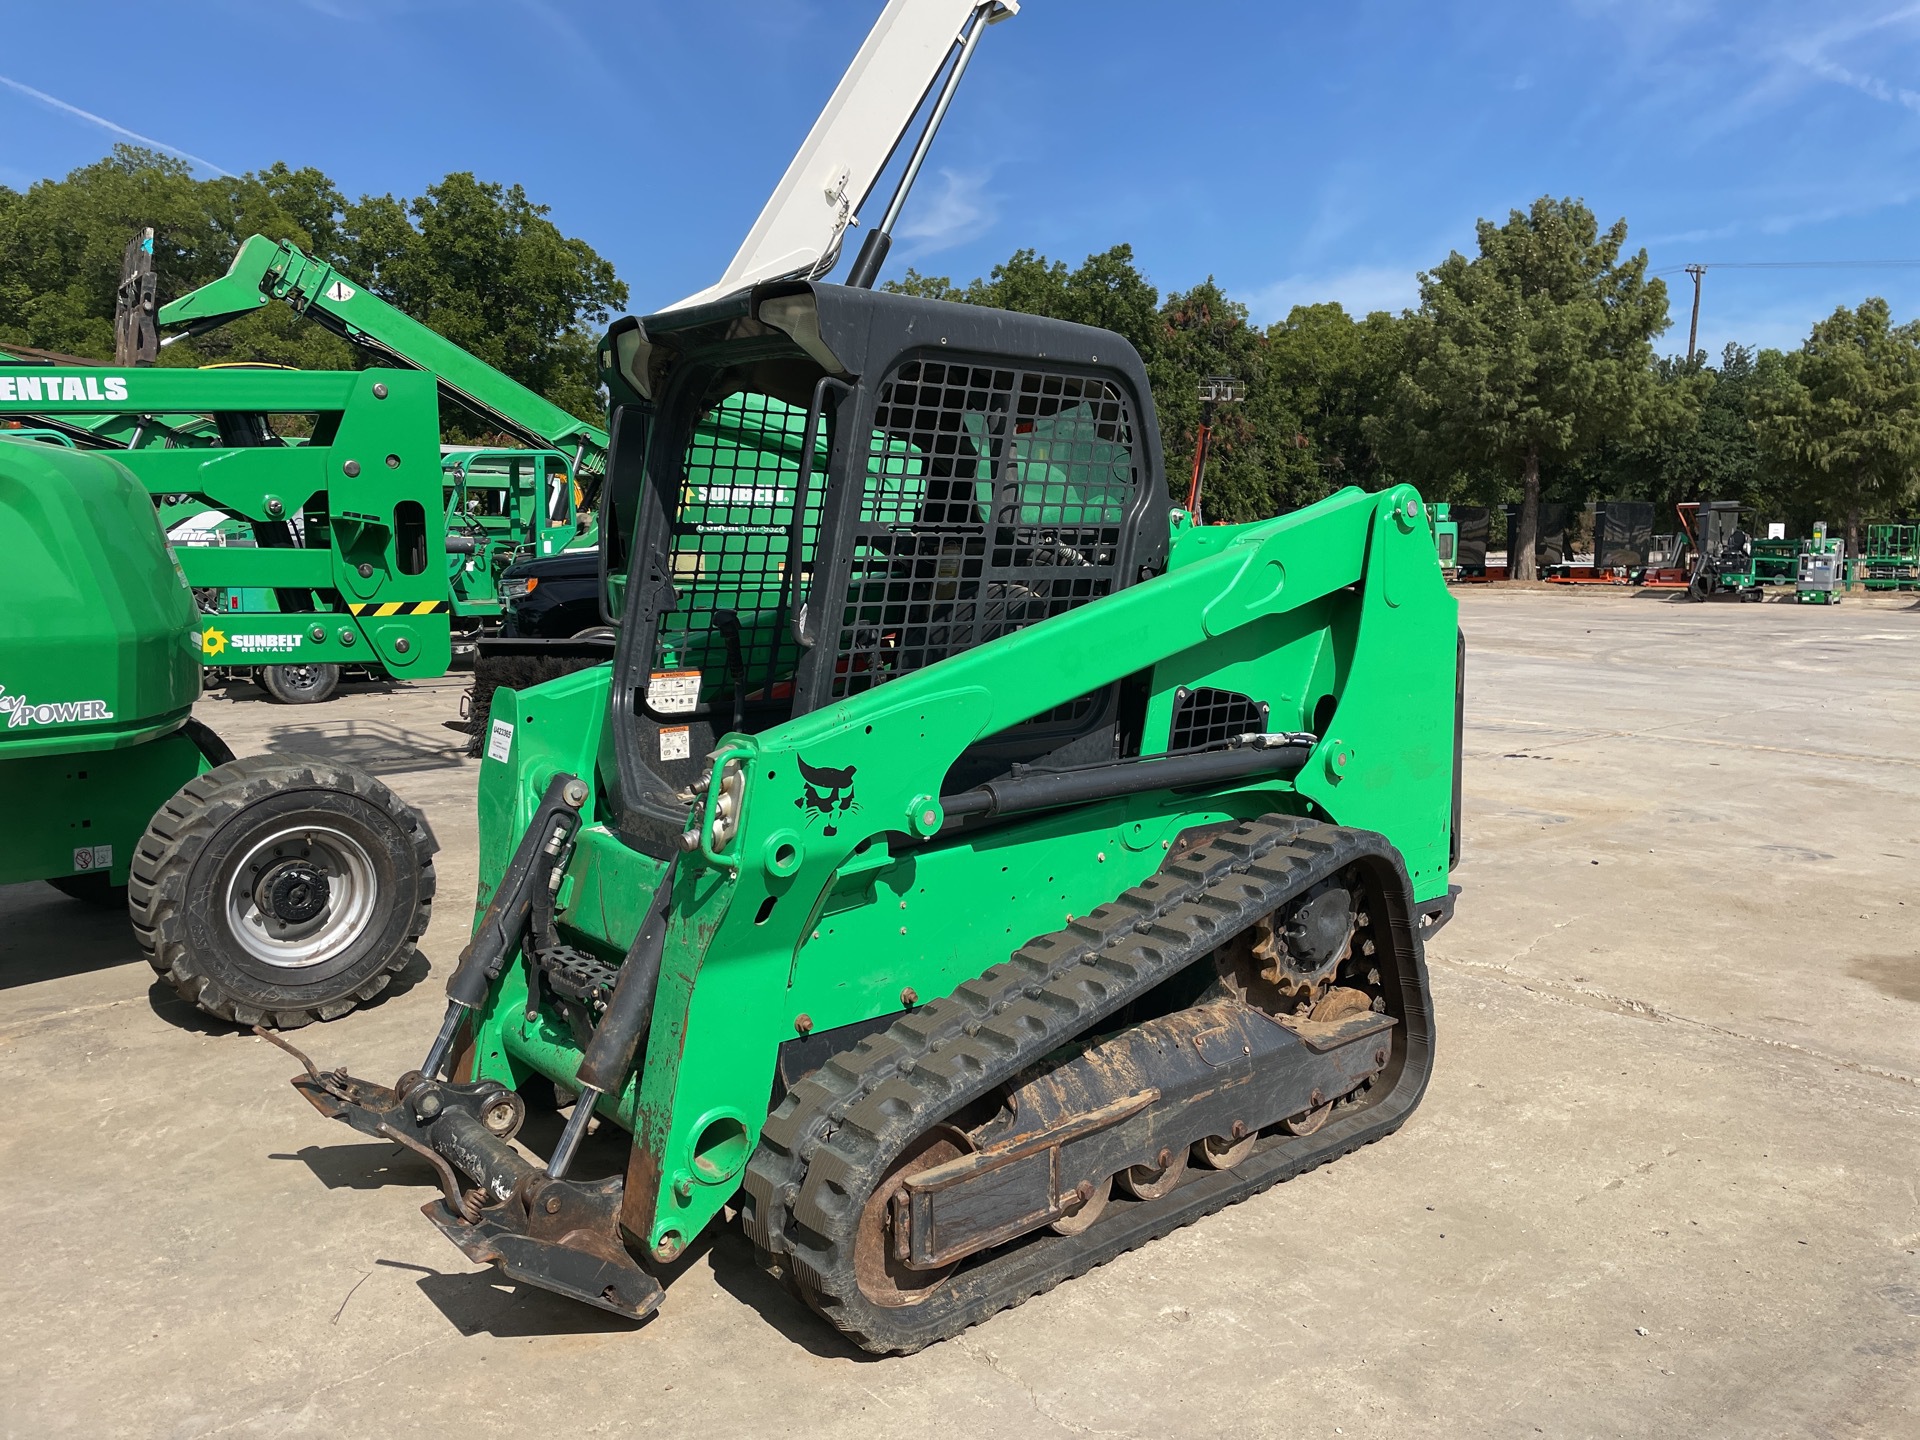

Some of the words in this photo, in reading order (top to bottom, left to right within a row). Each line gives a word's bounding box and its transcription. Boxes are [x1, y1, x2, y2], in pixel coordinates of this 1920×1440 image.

[0, 377, 128, 401] ENTALS
[698, 484, 787, 503] SUNBELT
[231, 635, 303, 647] SUNBELT
[19, 700, 106, 725] POWER
